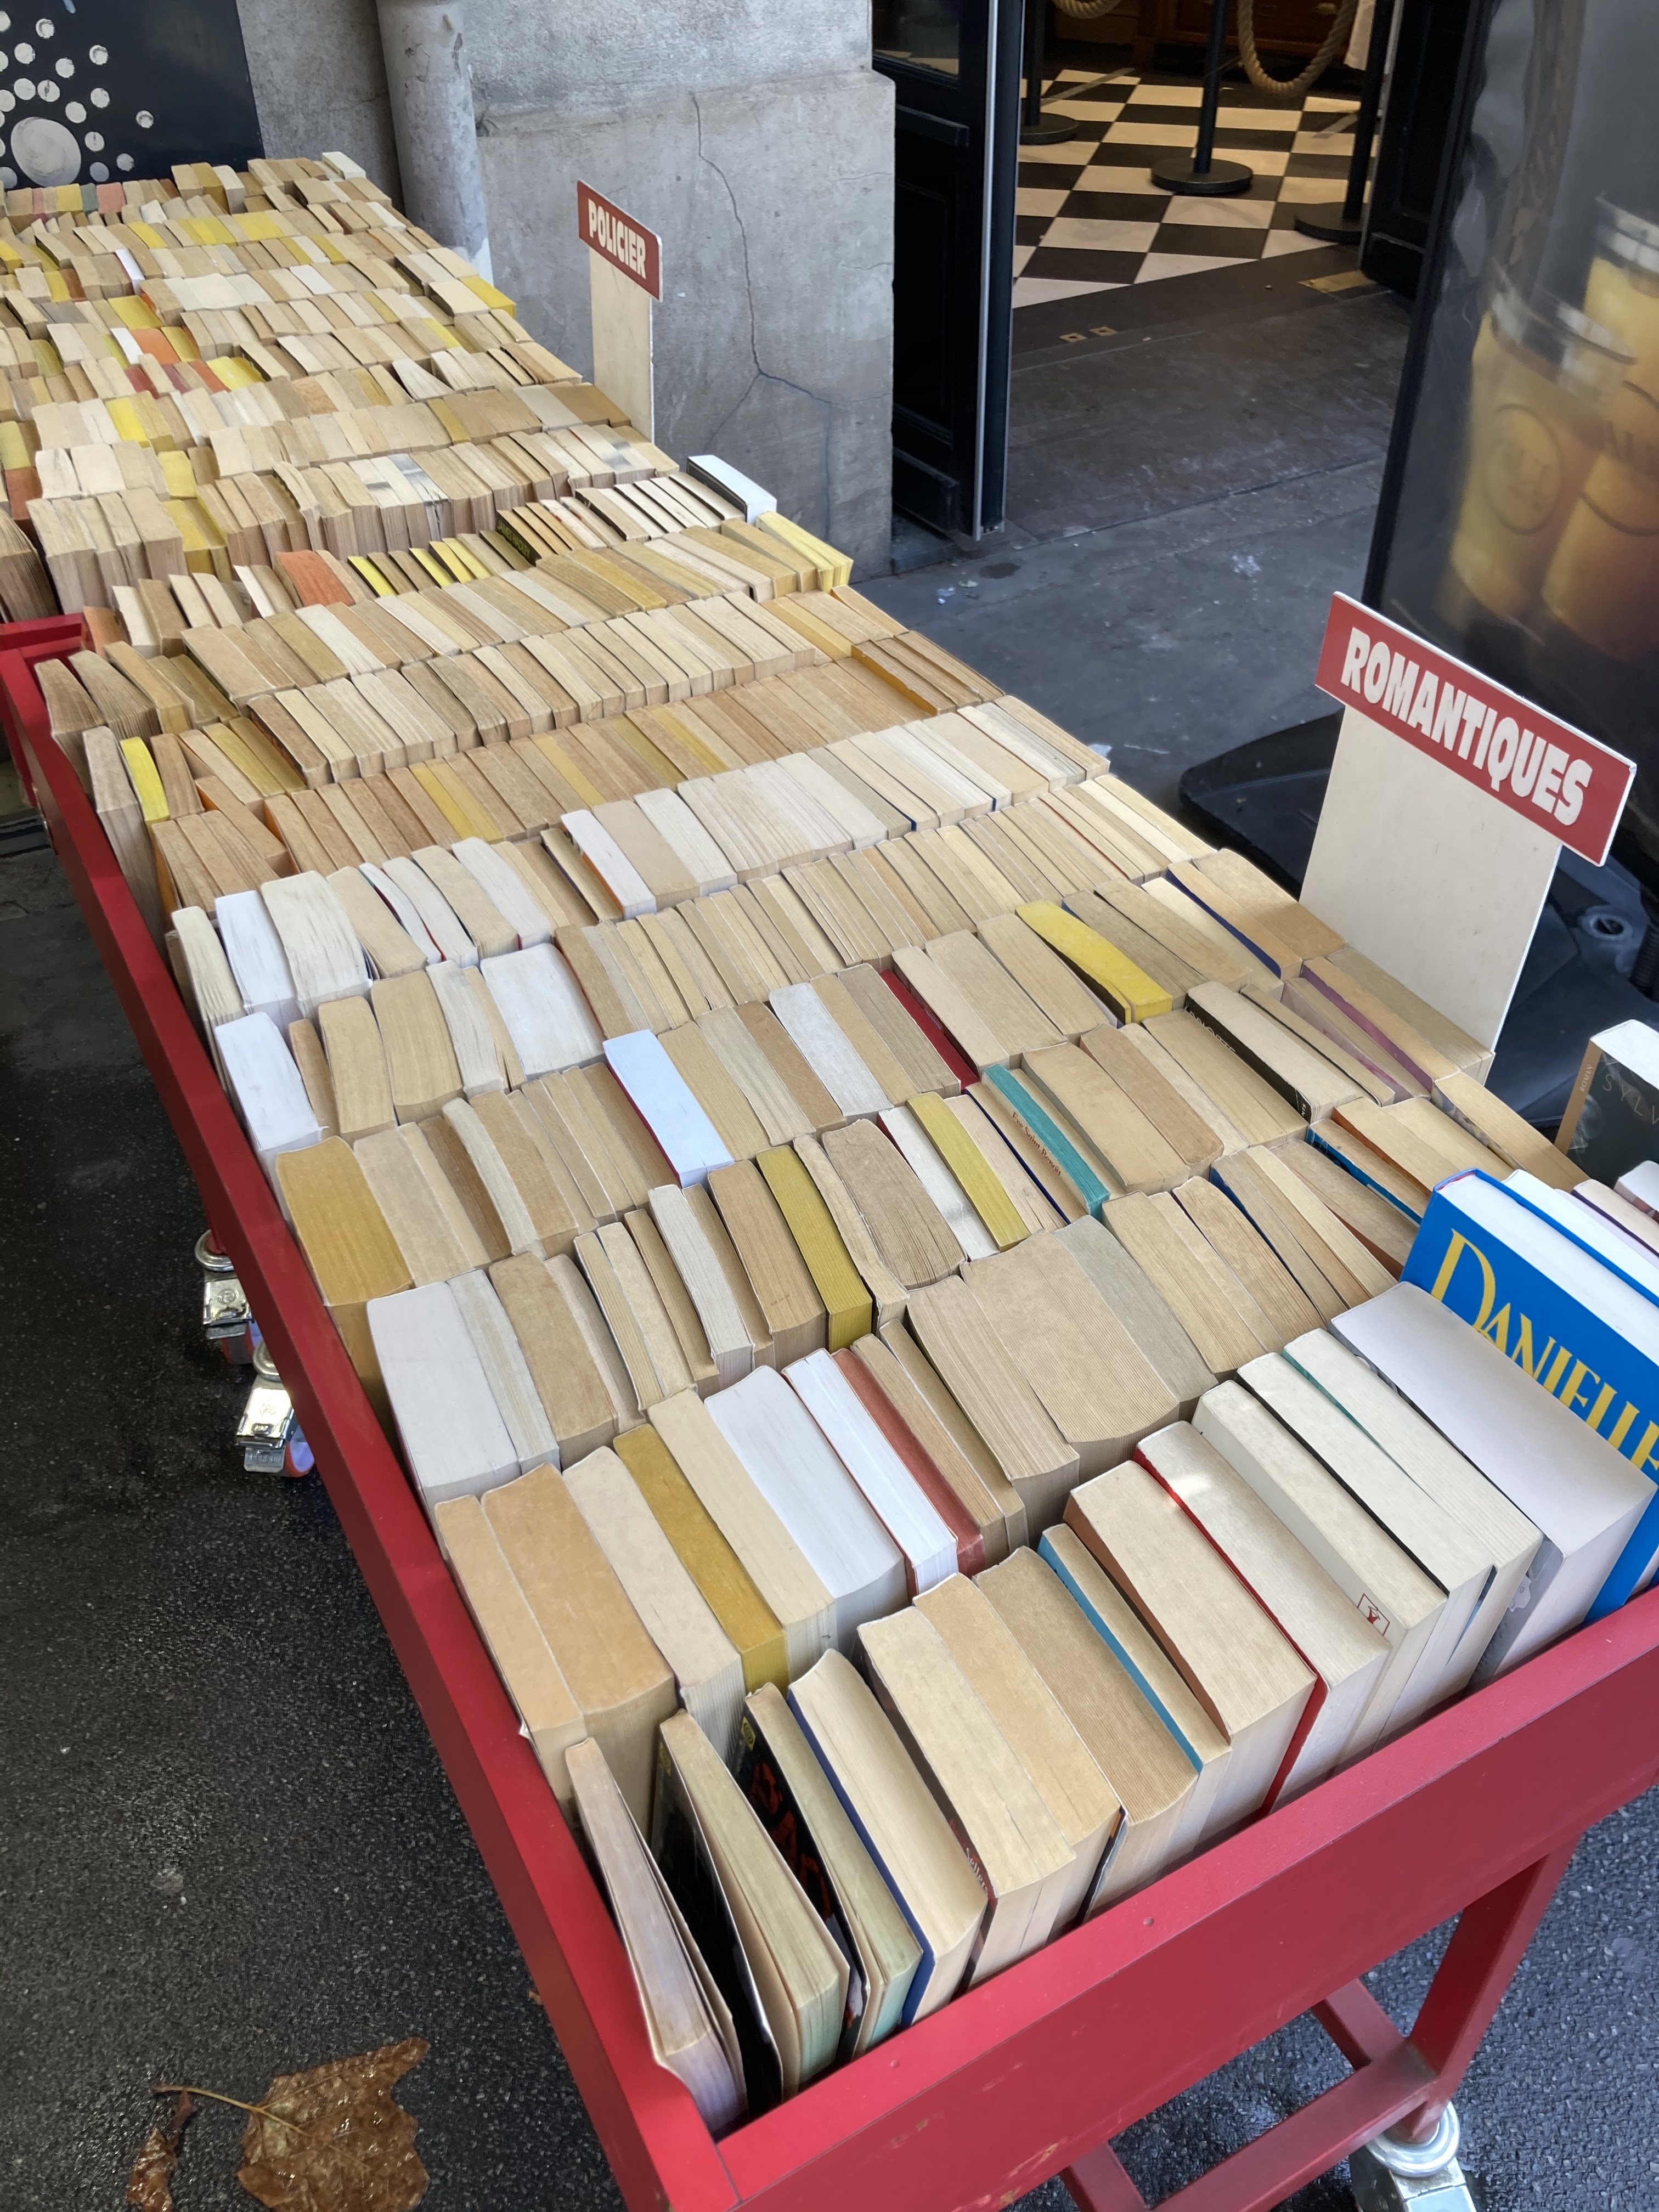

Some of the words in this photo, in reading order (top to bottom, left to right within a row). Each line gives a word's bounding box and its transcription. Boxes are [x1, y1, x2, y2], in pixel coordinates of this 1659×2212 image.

[588, 198, 646, 279] POLICIER
[1341, 627, 1593, 826] ROMANTIQUES
[1580, 1064, 1593, 1093] ROMAN
